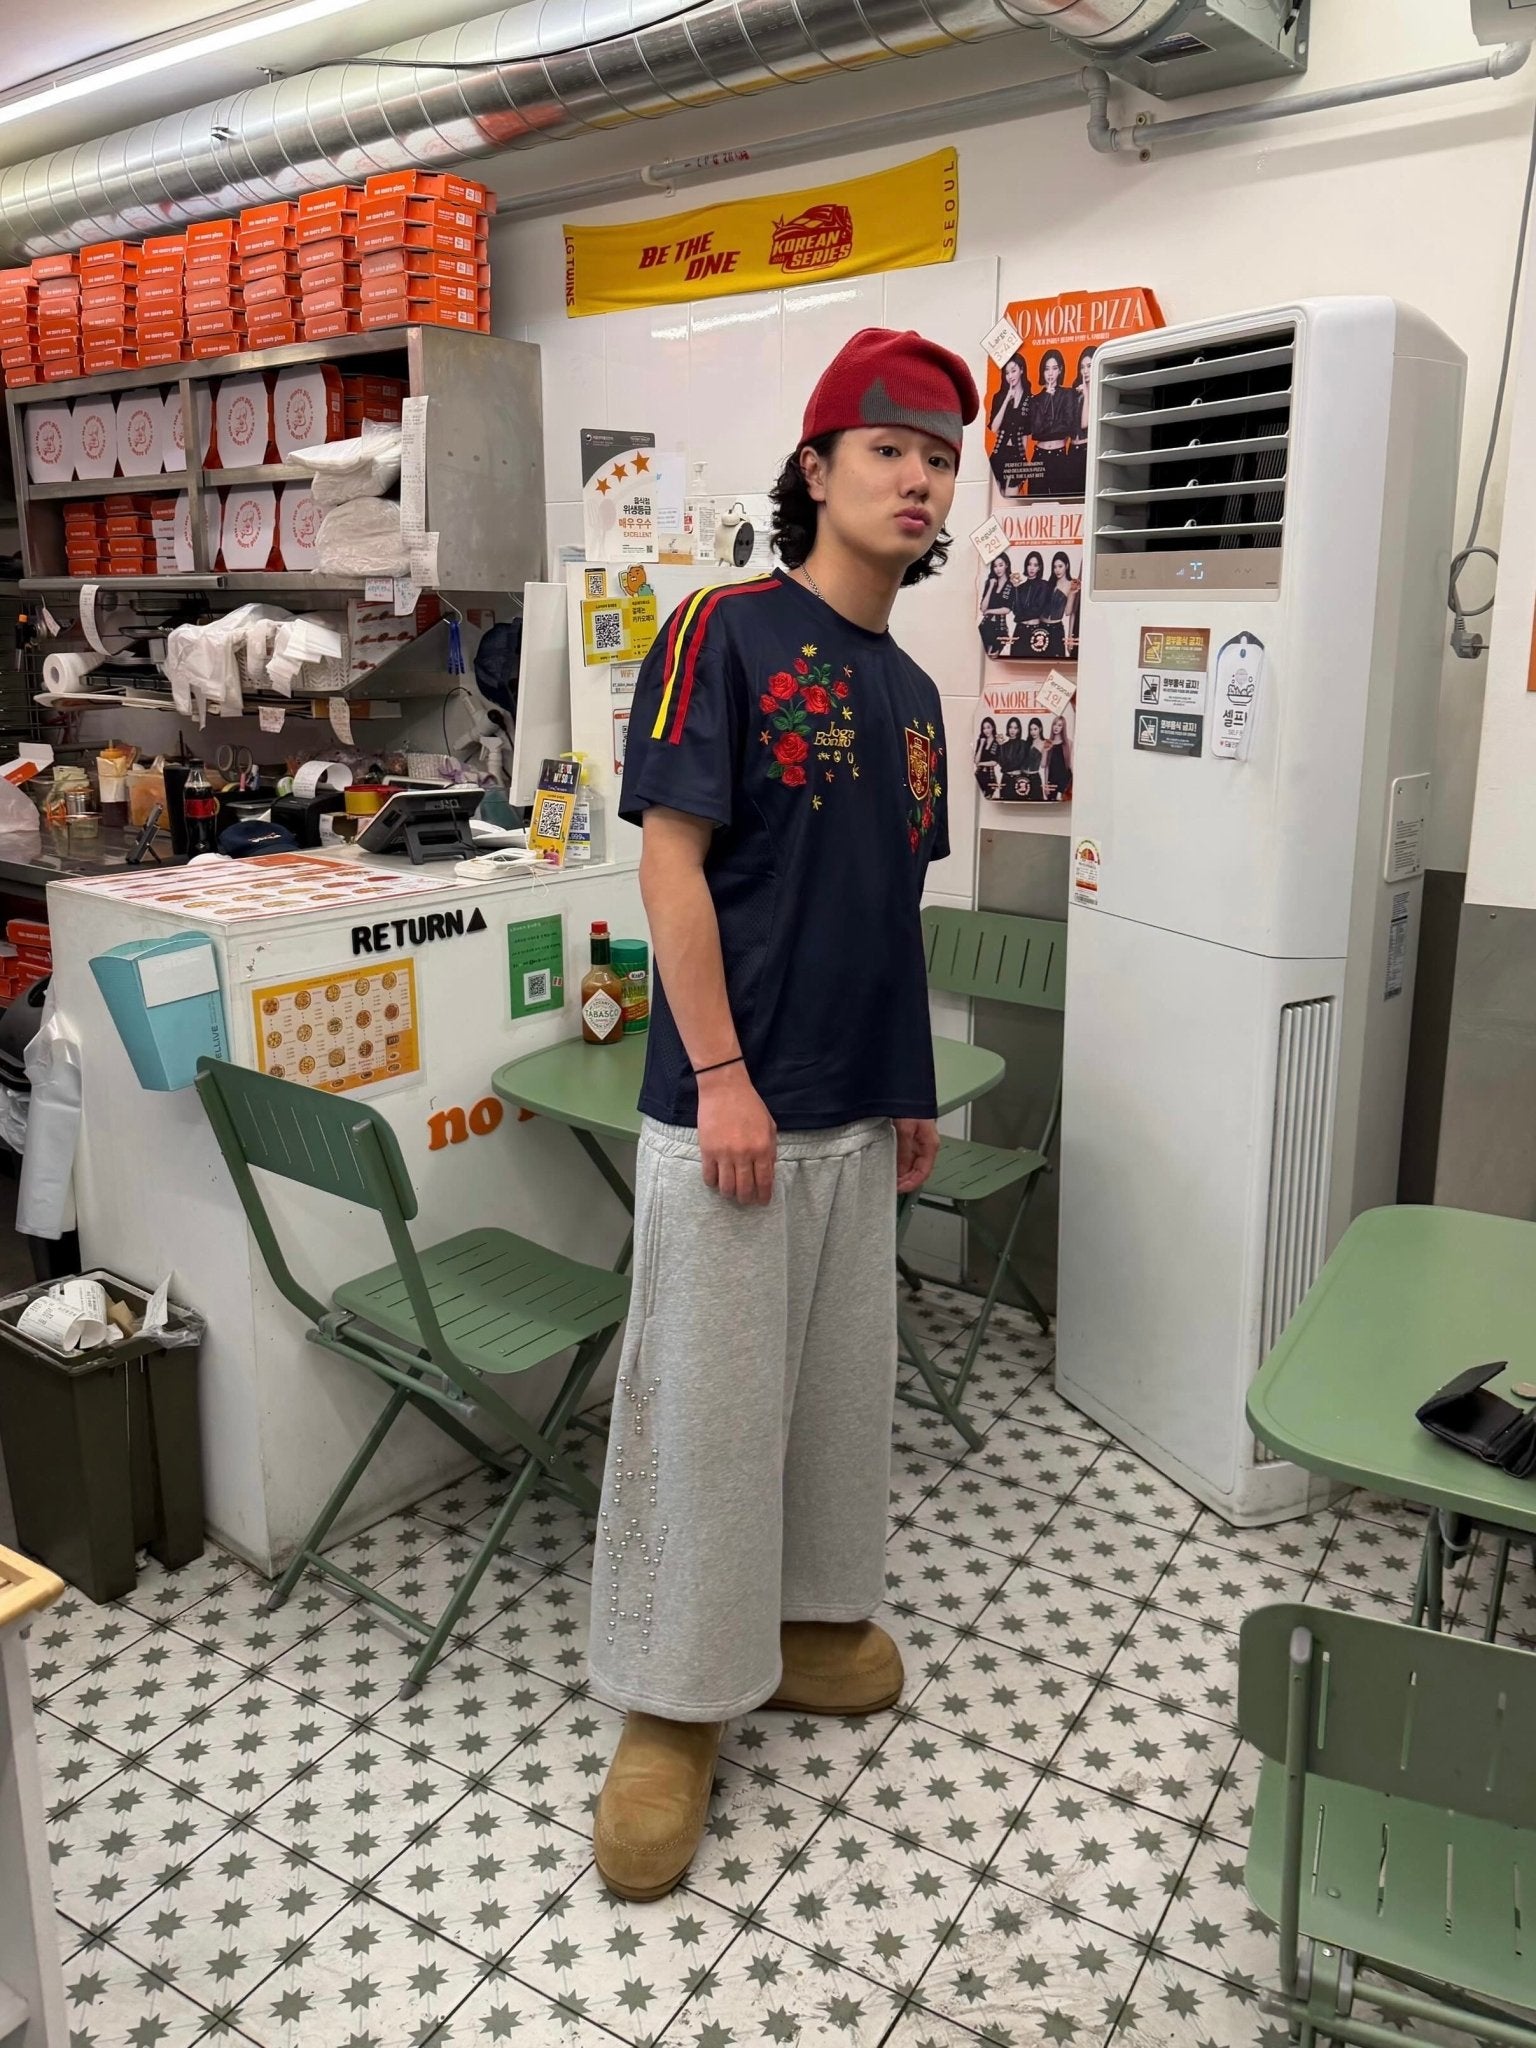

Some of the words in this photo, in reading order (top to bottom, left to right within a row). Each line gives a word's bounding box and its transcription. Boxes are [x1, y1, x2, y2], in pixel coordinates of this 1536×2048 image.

[944, 160, 956, 248] SEOUL
[564, 236, 574, 254] LG
[638, 245, 672, 270] BE
[674, 231, 715, 264] THE
[772, 230, 840, 256] KOREAN
[684, 251, 741, 282] ONE
[790, 244, 850, 268] SERIES
[566, 258, 576, 306] TWINS
[1034, 304, 1086, 337] MORE
[1090, 296, 1144, 332] PIZZA
[988, 328, 1008, 349] Large
[993, 332, 1018, 362] 3-4인
[623, 505, 652, 516] 위생등급
[634, 496, 650, 505] 음식점
[974, 524, 998, 545] Regular
[1002, 516, 1013, 538] O
[1017, 514, 1056, 538] MORE
[985, 536, 1002, 554] 2인
[1166, 636, 1188, 645] 외부음식
[1048, 675, 1072, 697] Personal
[1163, 678, 1184, 688] 외부음식
[984, 691, 999, 708] NO
[1000, 690, 1028, 708] MORE
[1045, 691, 1062, 707] 1인
[826, 721, 854, 740] Joga
[1161, 720, 1181, 730] 외부음식
[813, 731, 850, 747] Bonito
[352, 909, 464, 955] RETURN
[585, 1008, 618, 1018] TABASCO
[427, 1097, 503, 1151] no
